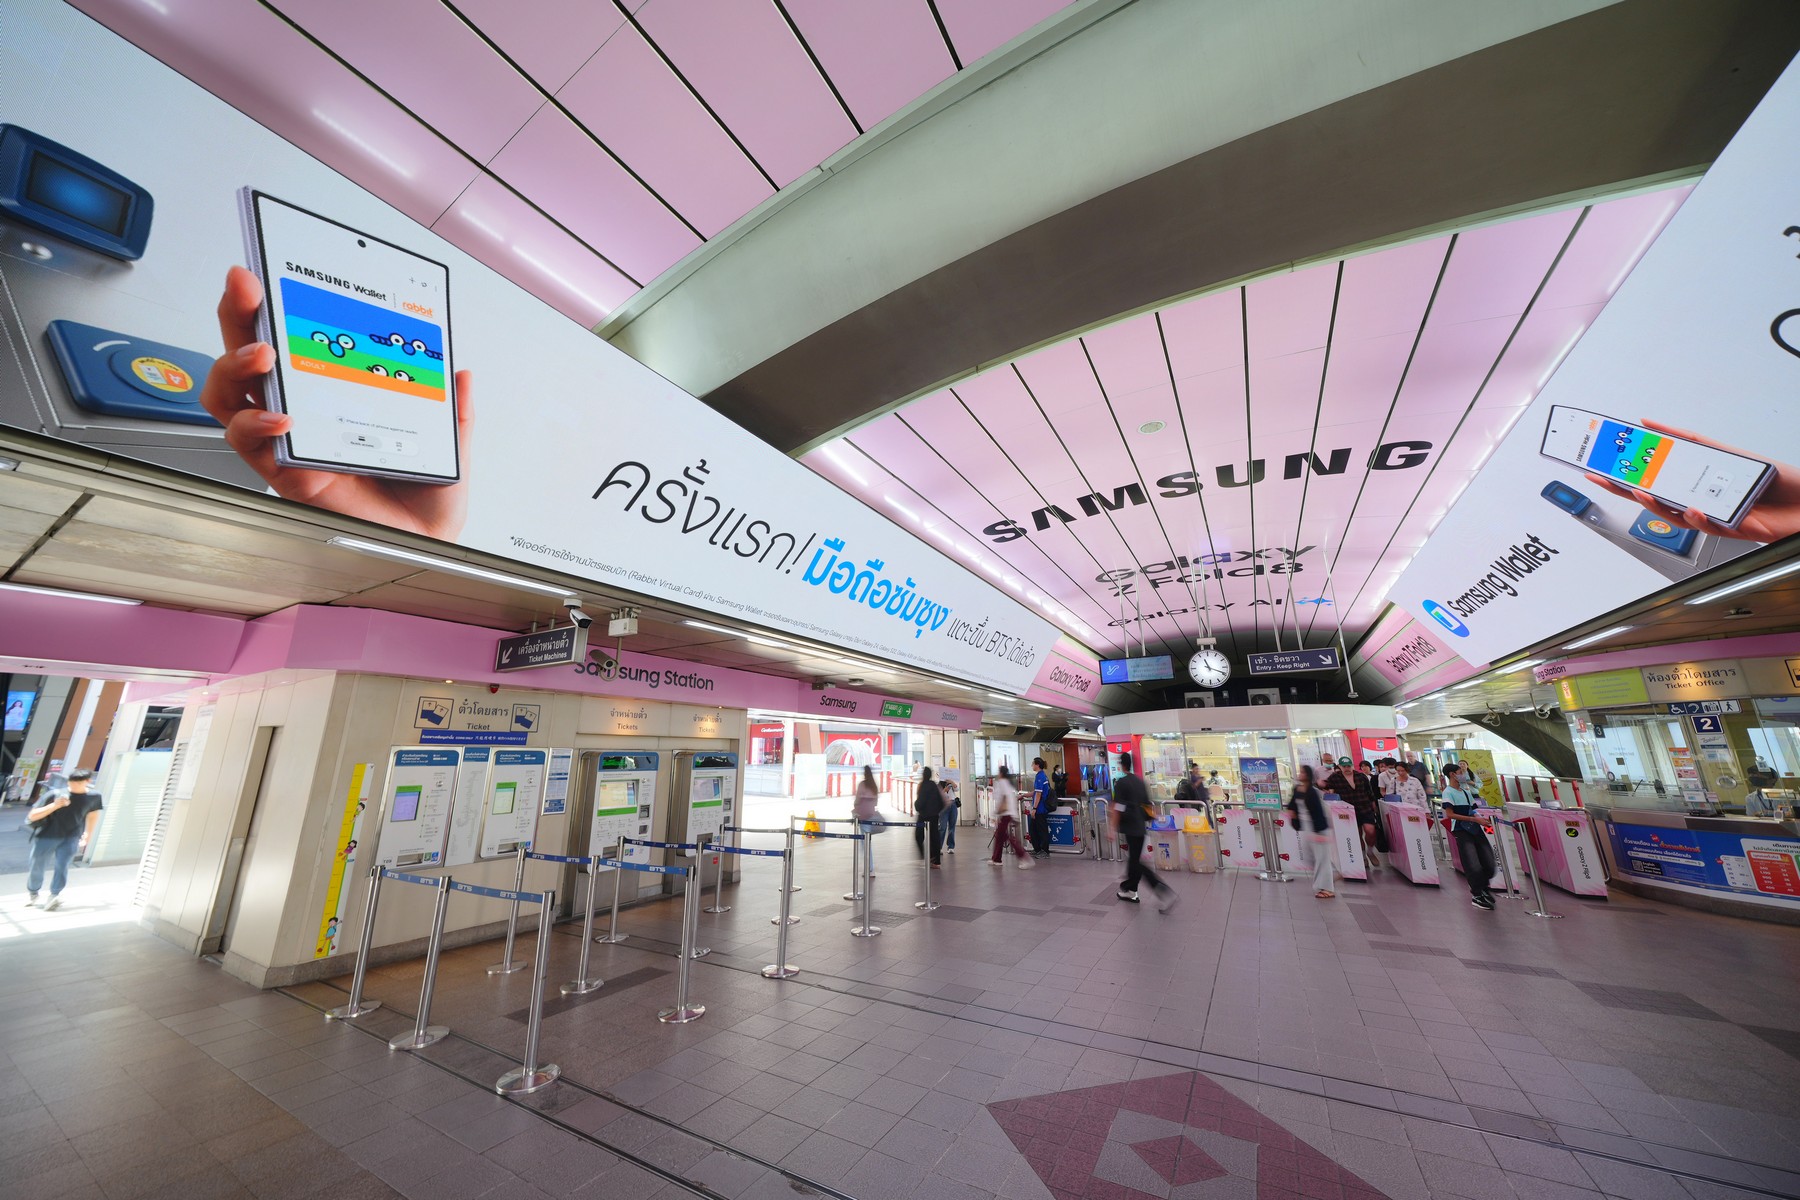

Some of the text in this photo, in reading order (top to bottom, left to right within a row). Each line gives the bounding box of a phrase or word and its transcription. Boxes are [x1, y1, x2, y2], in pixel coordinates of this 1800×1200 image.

[285, 261, 387, 301] SAMSUNG Wallet
[402, 301, 433, 317] rabbit
[300, 360, 326, 371] ADULT
[983, 440, 1433, 543] SAMSUNG
[592, 458, 816, 574] ครั้งแรก!
[947, 616, 989, 648] แตะขึ้น
[985, 631, 1012, 657] BTS
[1007, 637, 1035, 667] ได้แล้ว
[1095, 546, 1317, 583] Galaxy
[1108, 562, 1304, 597] Z Fold8
[1447, 532, 1560, 617] Samsung Wallet
[628, 570, 658, 585] (Rabbit
[659, 579, 682, 593] Virtual
[684, 586, 704, 600] Card)
[716, 596, 744, 611] Samsung
[745, 604, 763, 616] Wallet
[1107, 598, 1283, 627] Galaxy AI
[518, 631, 569, 655] เครื่องจำหน่ายตั๋ว
[529, 651, 567, 663] Ticket Machines
[1255, 656, 1268, 665] เข้า
[1273, 655, 1300, 663] ชิดขวา
[1544, 665, 1566, 677] Station
[1647, 667, 1736, 683] ห้องตั๋วโดยสาร
[664, 670, 714, 691] Station
[459, 699, 509, 717] ตั๋วโดยสาร
[610, 707, 648, 720] จำหน่ายตั๋ว
[820, 695, 958, 721] Samsung Station
[1596, 726, 1602, 736] 3
[1700, 718, 1714, 730] 2
[420, 877, 434, 885] BTS
[457, 884, 473, 892] BTS
[500, 891, 517, 899] BTS
